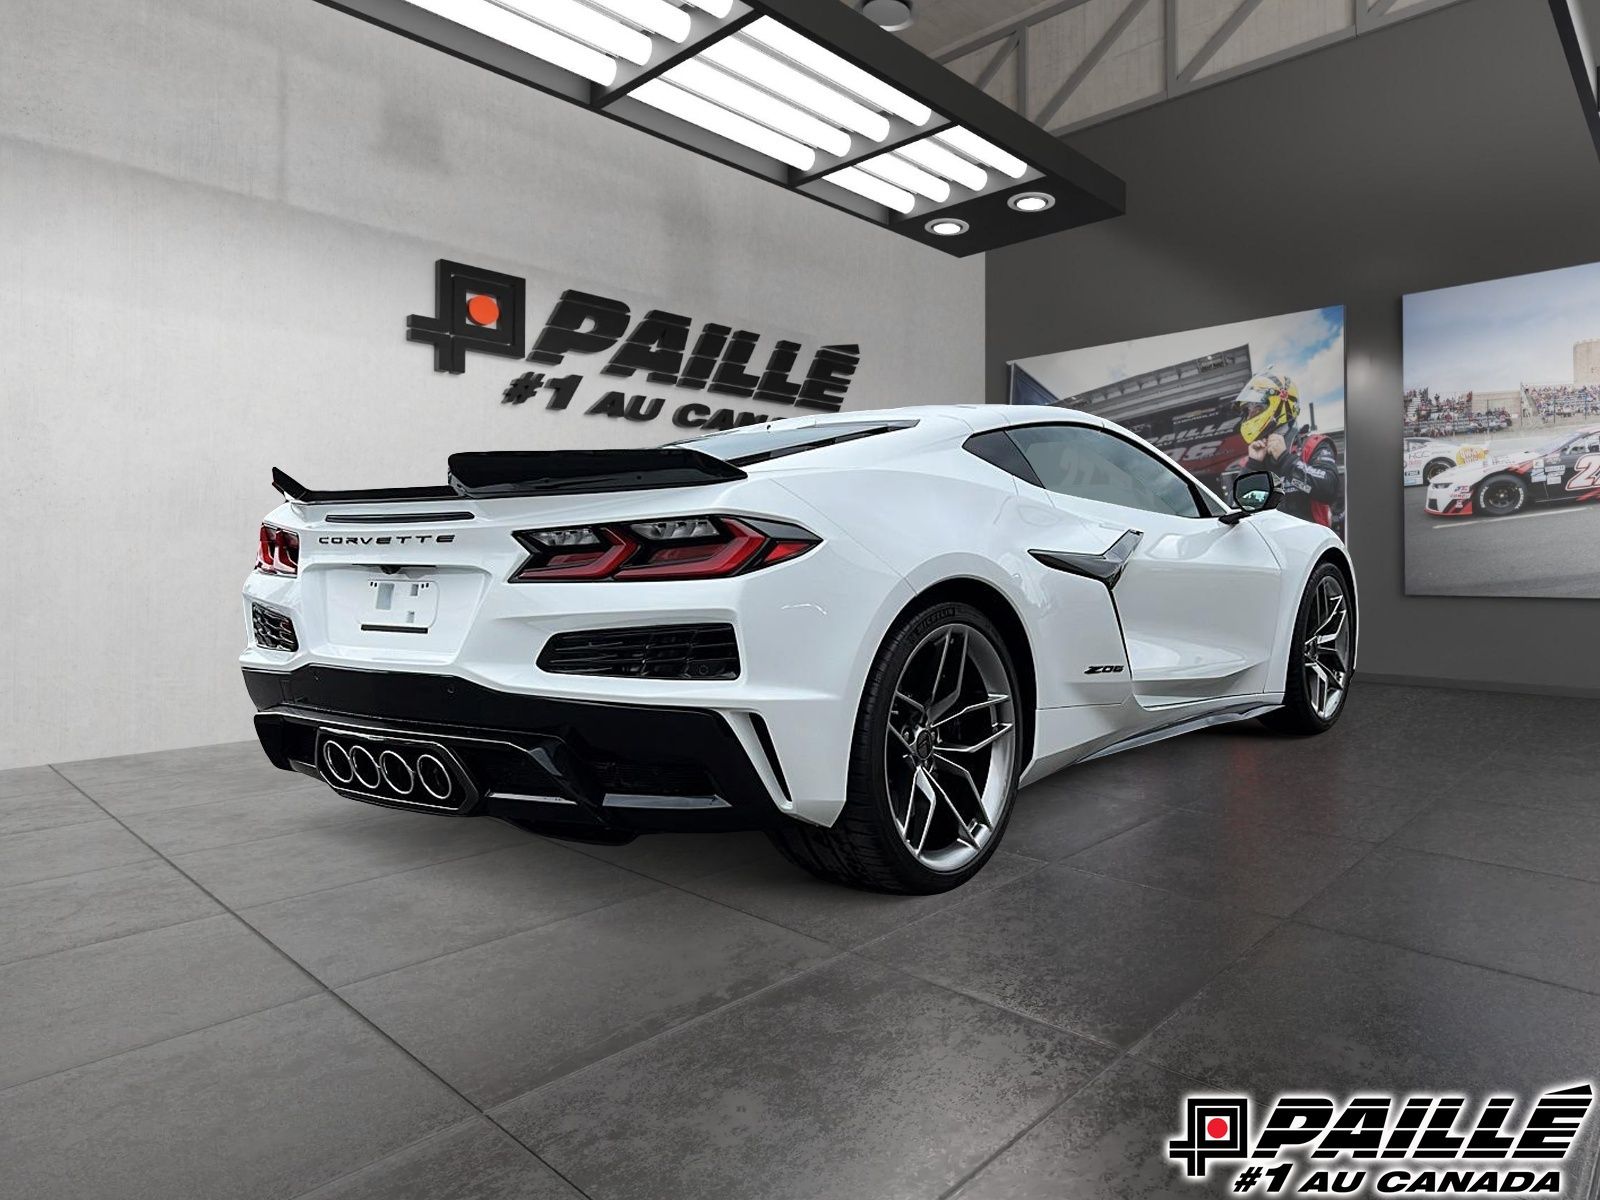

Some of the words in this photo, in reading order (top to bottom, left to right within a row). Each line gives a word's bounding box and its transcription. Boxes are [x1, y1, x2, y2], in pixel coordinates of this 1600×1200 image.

[525, 289, 860, 412] PAILLÉ
[501, 371, 583, 410] #1
[584, 391, 666, 422] AU
[672, 403, 788, 431] CAN
[318, 534, 456, 546] CORVETTE
[1084, 665, 1125, 675] Z06
